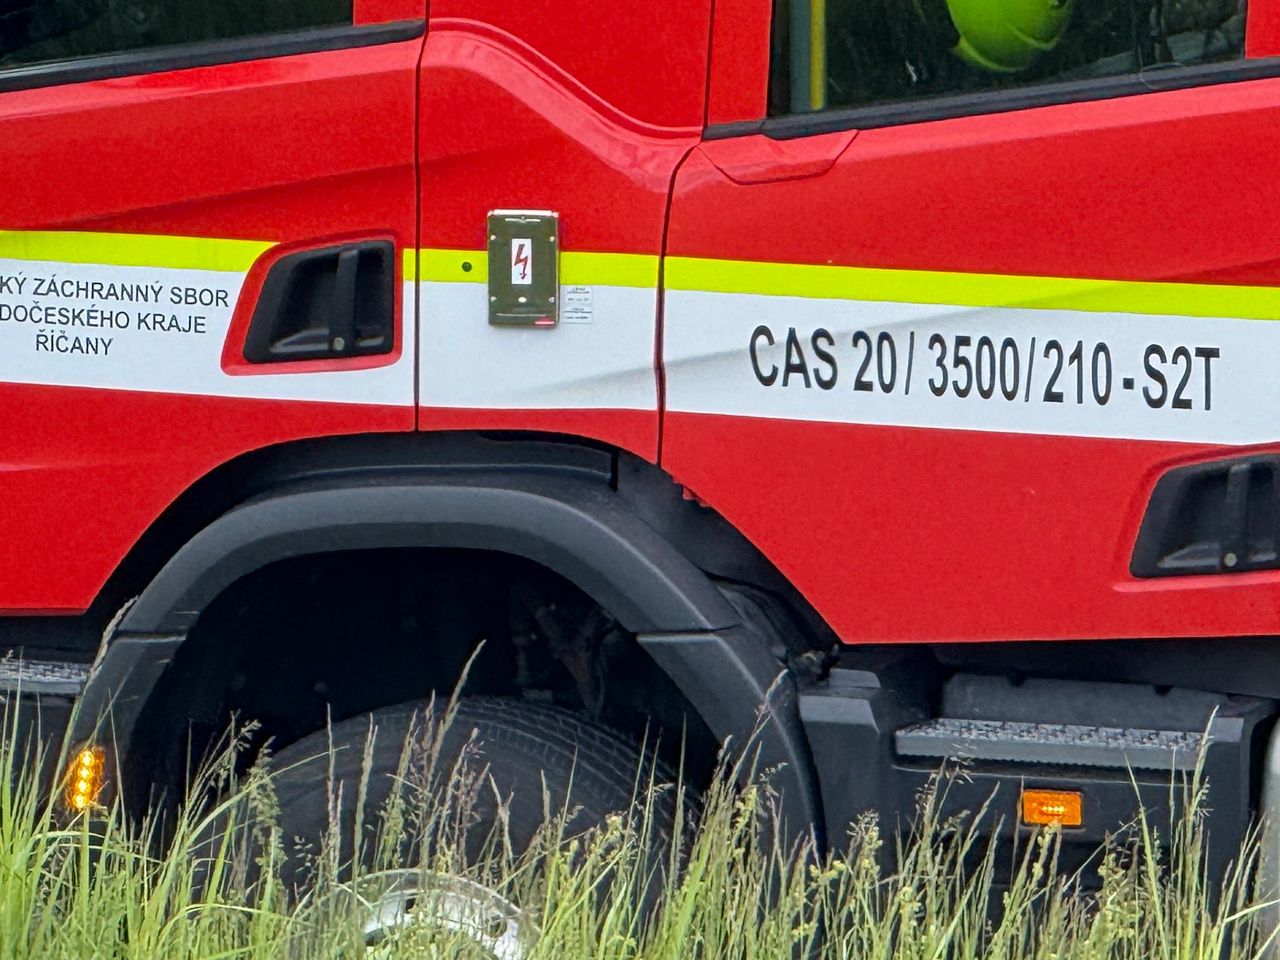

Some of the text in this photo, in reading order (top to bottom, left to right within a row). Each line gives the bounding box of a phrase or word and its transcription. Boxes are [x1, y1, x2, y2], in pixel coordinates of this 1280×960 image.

[32, 273, 163, 303] ZÁCHRANNÝ
[170, 286, 229, 307] SBOR
[137, 312, 207, 334] KRAJE
[35, 328, 114, 356] ŘÍČANY
[748, 325, 839, 390] CAS
